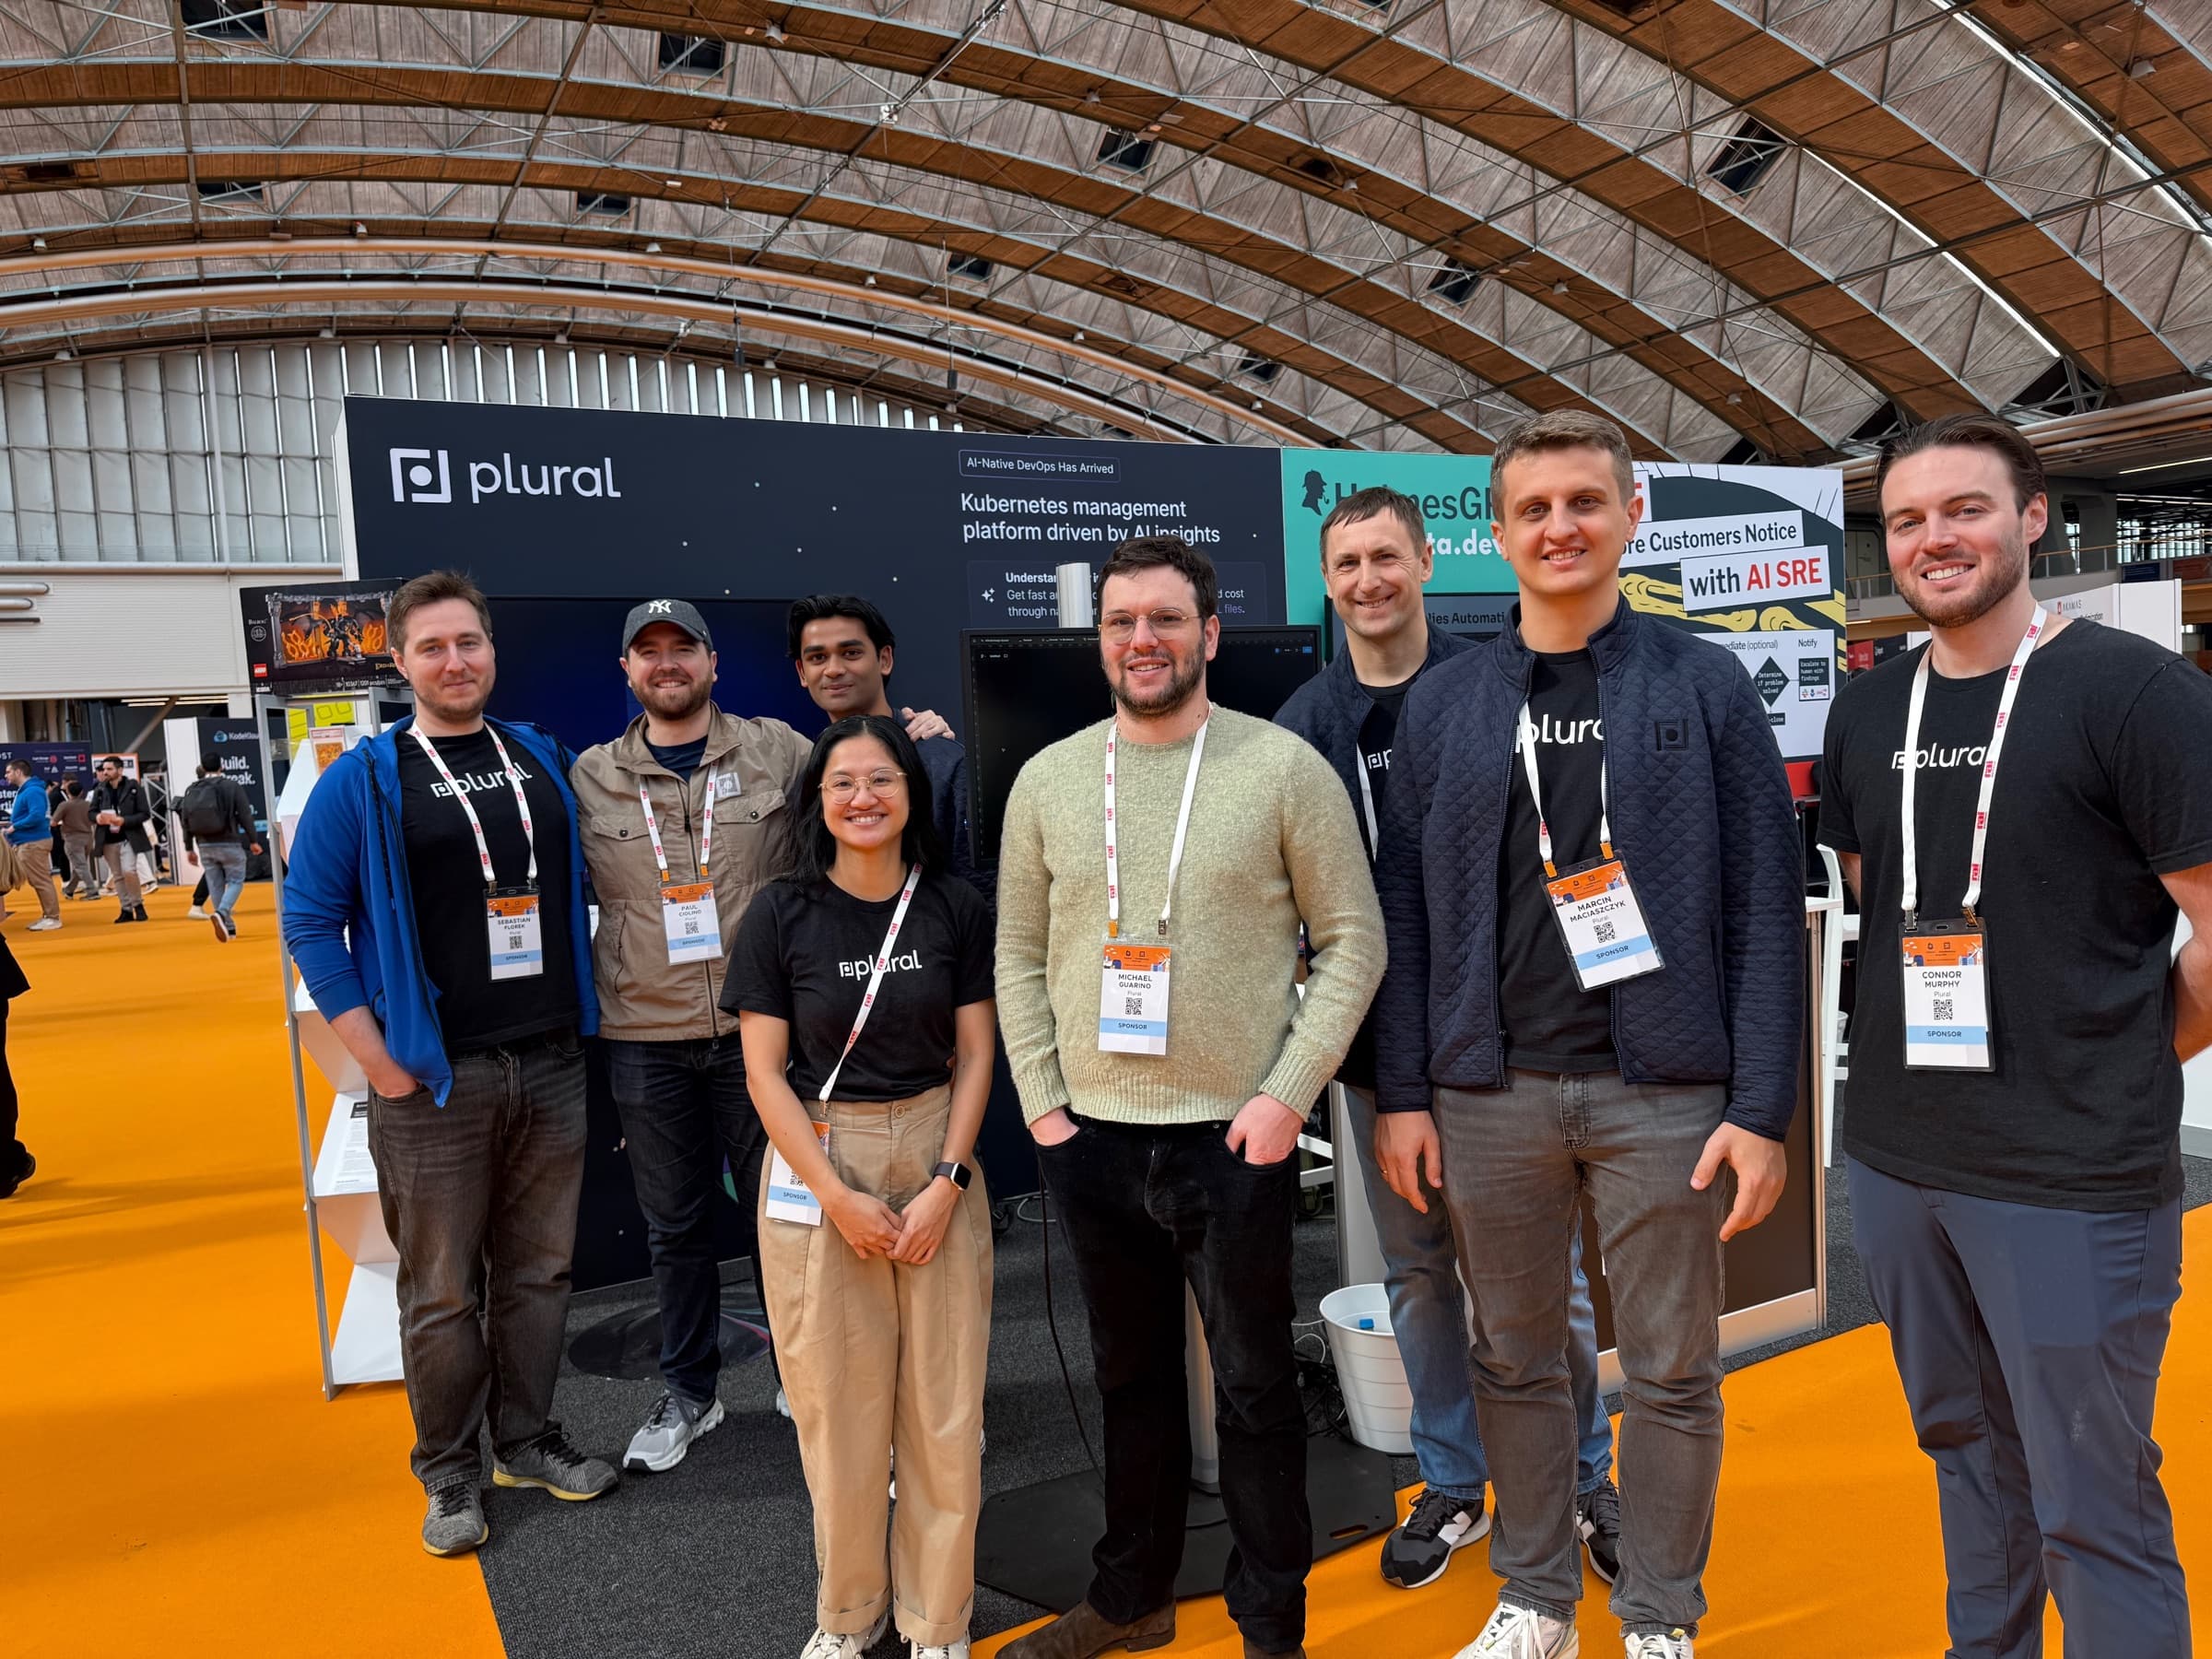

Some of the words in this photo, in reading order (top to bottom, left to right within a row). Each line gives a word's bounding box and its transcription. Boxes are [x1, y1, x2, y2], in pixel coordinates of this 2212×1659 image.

[967, 457, 1015, 470] AI-Native
[1017, 460, 1056, 473] DevOps
[1058, 462, 1077, 473] Has
[1079, 463, 1114, 474] Arrived
[469, 453, 621, 504] plural
[960, 493, 1068, 514] Kubernetes
[1073, 499, 1187, 521] management
[963, 521, 1041, 543] platform
[1046, 523, 1102, 541] driven
[1107, 524, 1129, 542] by
[1134, 524, 1150, 538] AI
[1649, 530, 1742, 551] Customers
[1745, 522, 1796, 543] Notice
[1688, 567, 1741, 597] with
[1747, 562, 1771, 591] AI
[1776, 558, 1823, 587] SRE
[1006, 590, 1025, 600] Get
[1028, 589, 1047, 600] fast
[1224, 589, 1244, 598] cost
[1007, 606, 1048, 618] through
[1224, 604, 1245, 614] files.
[1451, 611, 1505, 624] Automati
[2026, 624, 2039, 639] rai
[1747, 640, 1778, 652] (optional)
[1798, 638, 1818, 649] Notify
[2009, 665, 2020, 680] rai
[1915, 743, 1987, 769] plura
[1984, 760, 1994, 778] rai
[1977, 811, 1985, 830] rai
[1971, 863, 1980, 881] rai
[1570, 900, 1627, 923] MACIASZCZYK
[1577, 896, 1612, 912] MARCIN
[498, 917, 531, 925] SEBASTIAN
[1595, 945, 1630, 959] SPONSOR
[1118, 973, 1153, 982] MICHAEL
[1922, 971, 1962, 979] CONNOR
[782, 1192, 807, 1200] SPONSOR
